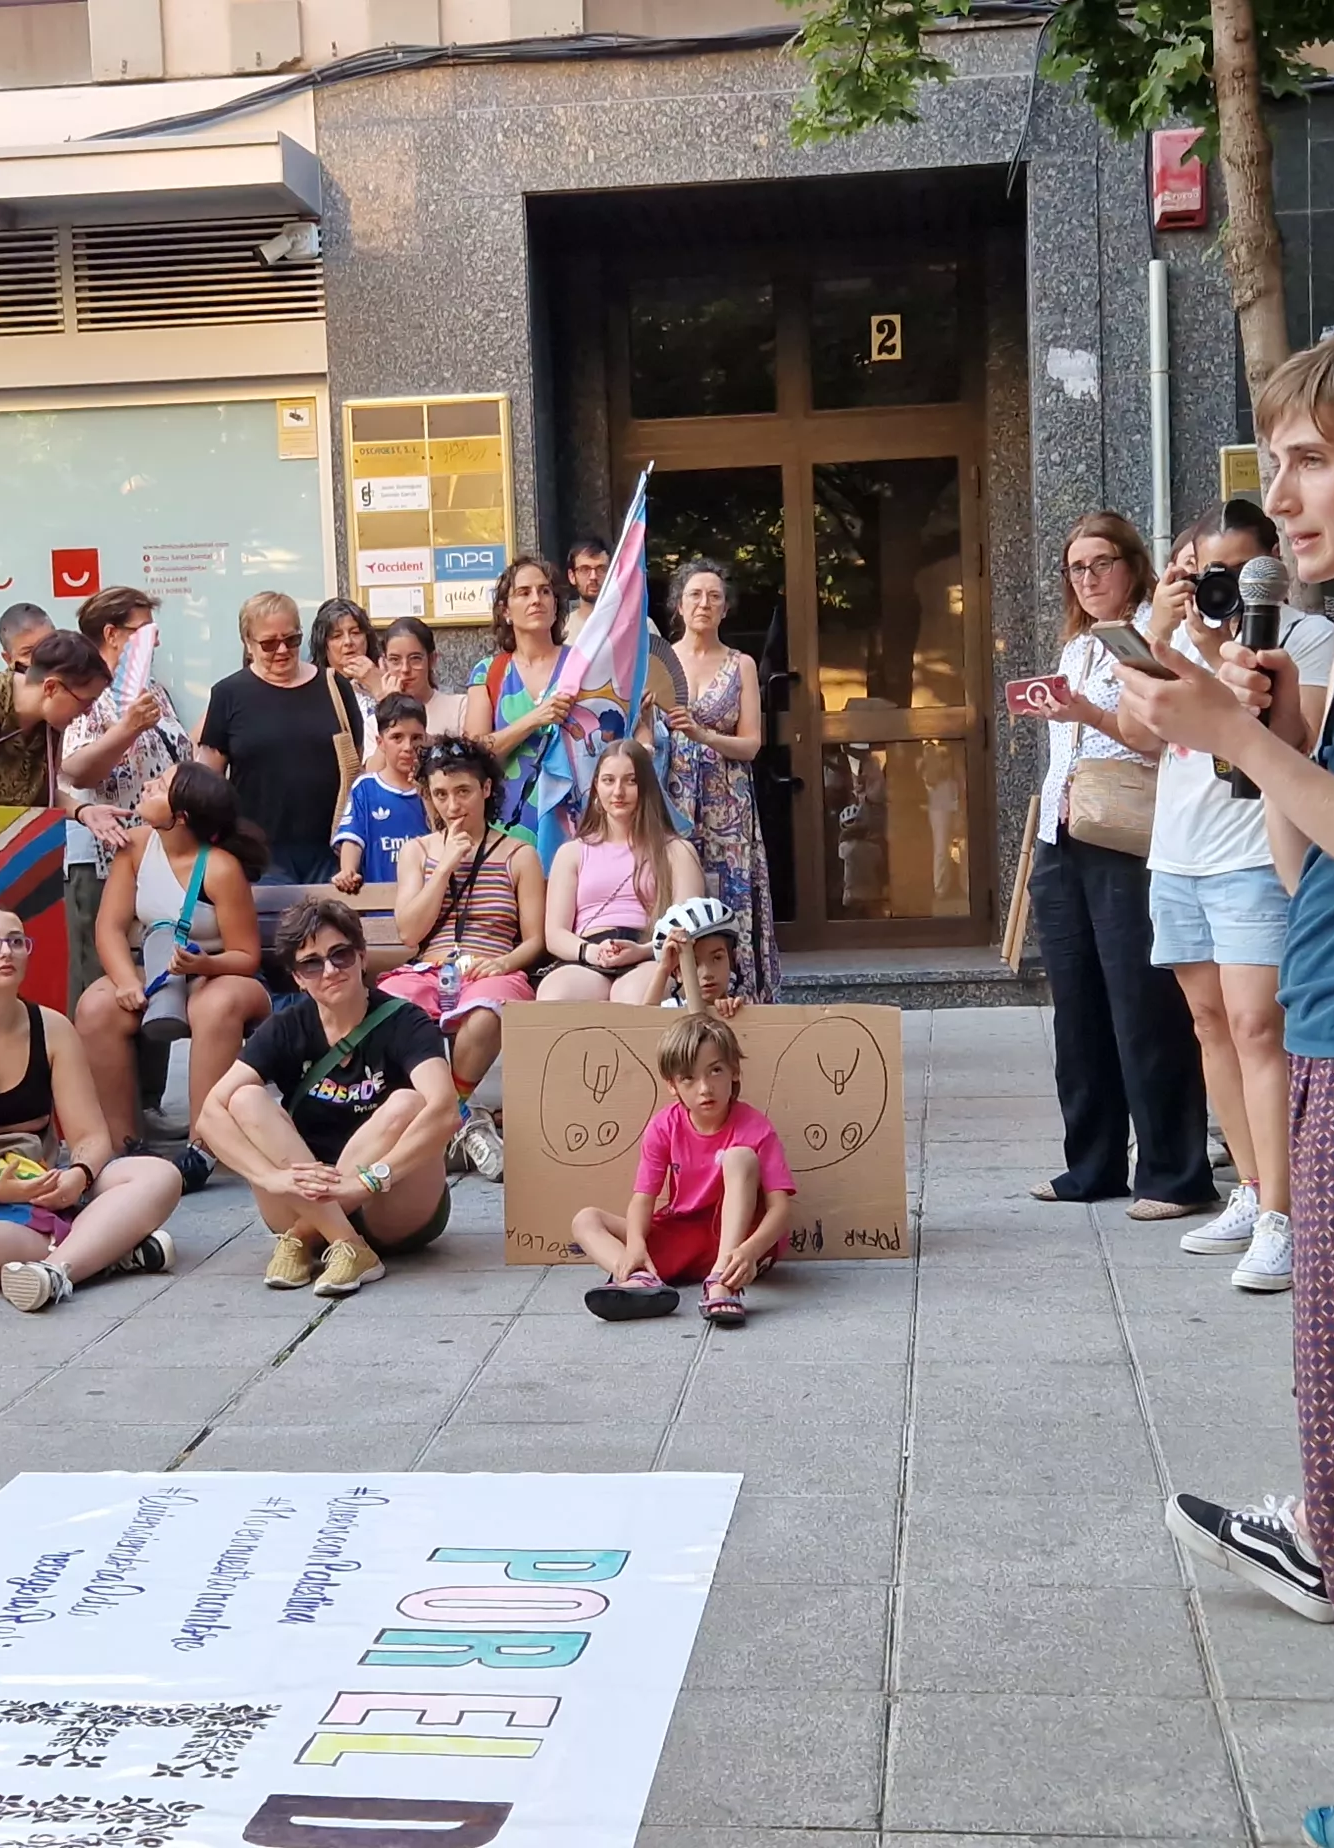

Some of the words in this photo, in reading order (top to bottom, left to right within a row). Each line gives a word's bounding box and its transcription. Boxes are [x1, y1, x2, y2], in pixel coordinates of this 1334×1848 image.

[876, 319, 896, 356] 2
[377, 562, 423, 572] Occident
[357, 1546, 631, 1669] POR
[294, 1691, 562, 1767] EL
